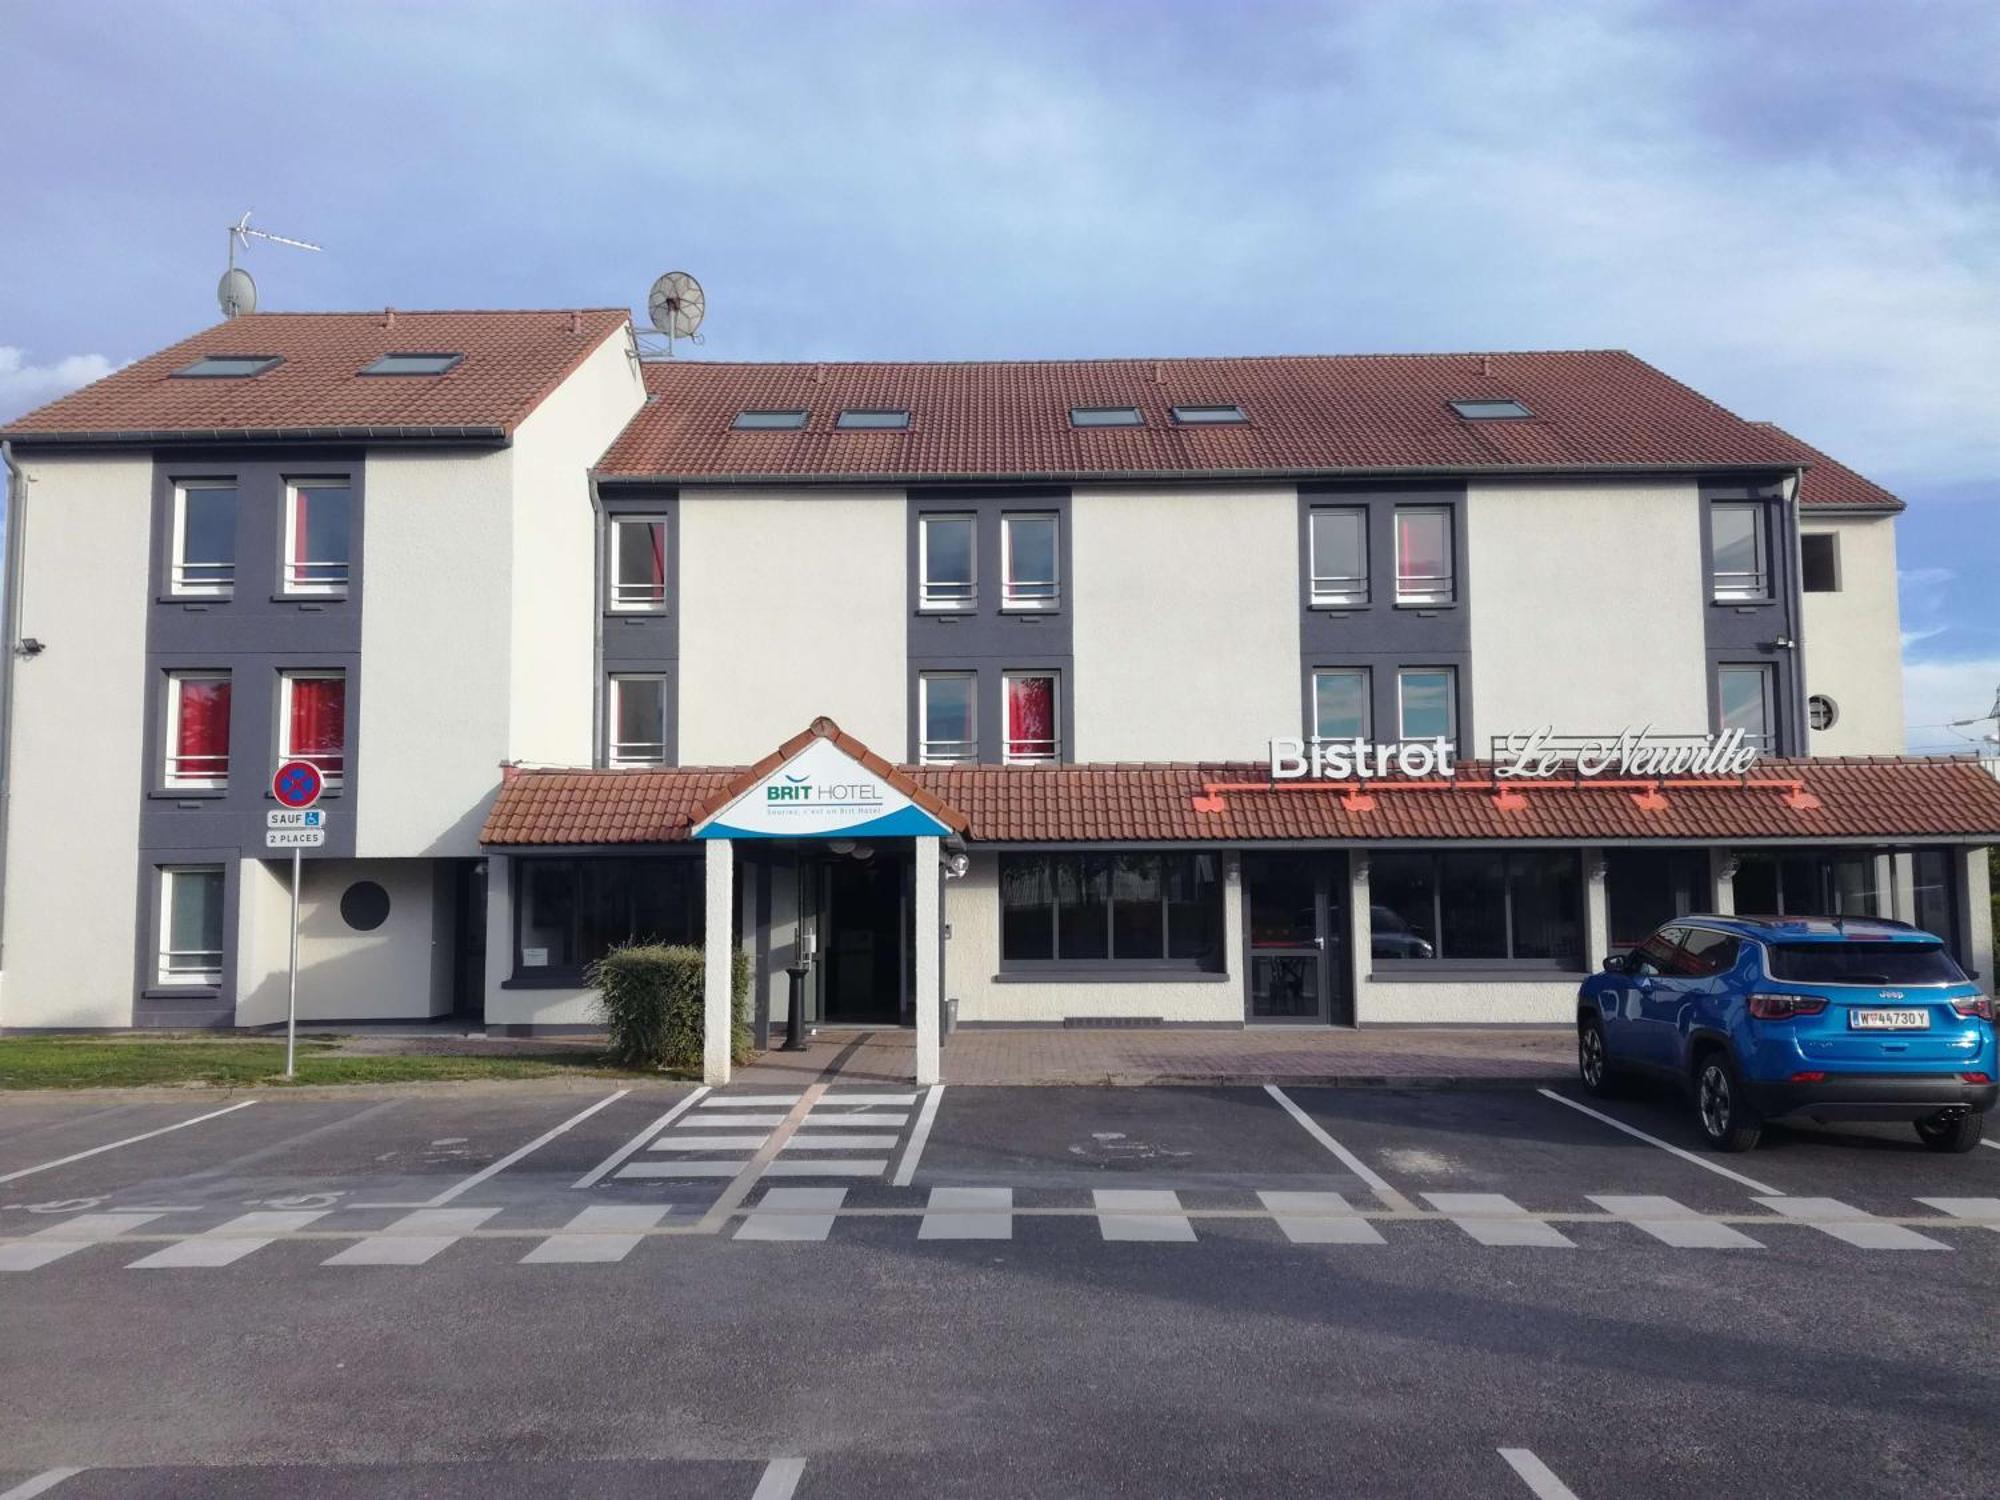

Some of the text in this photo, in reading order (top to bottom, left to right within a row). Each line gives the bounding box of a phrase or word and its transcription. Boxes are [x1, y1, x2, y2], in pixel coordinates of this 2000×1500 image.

[1271, 736, 1455, 779] Bistrot
[1495, 723, 1759, 777] Le Neuville
[768, 785, 883, 800] BRIT HOTEL
[271, 814, 302, 824] SAUF
[270, 834, 319, 843] 2 PLACES
